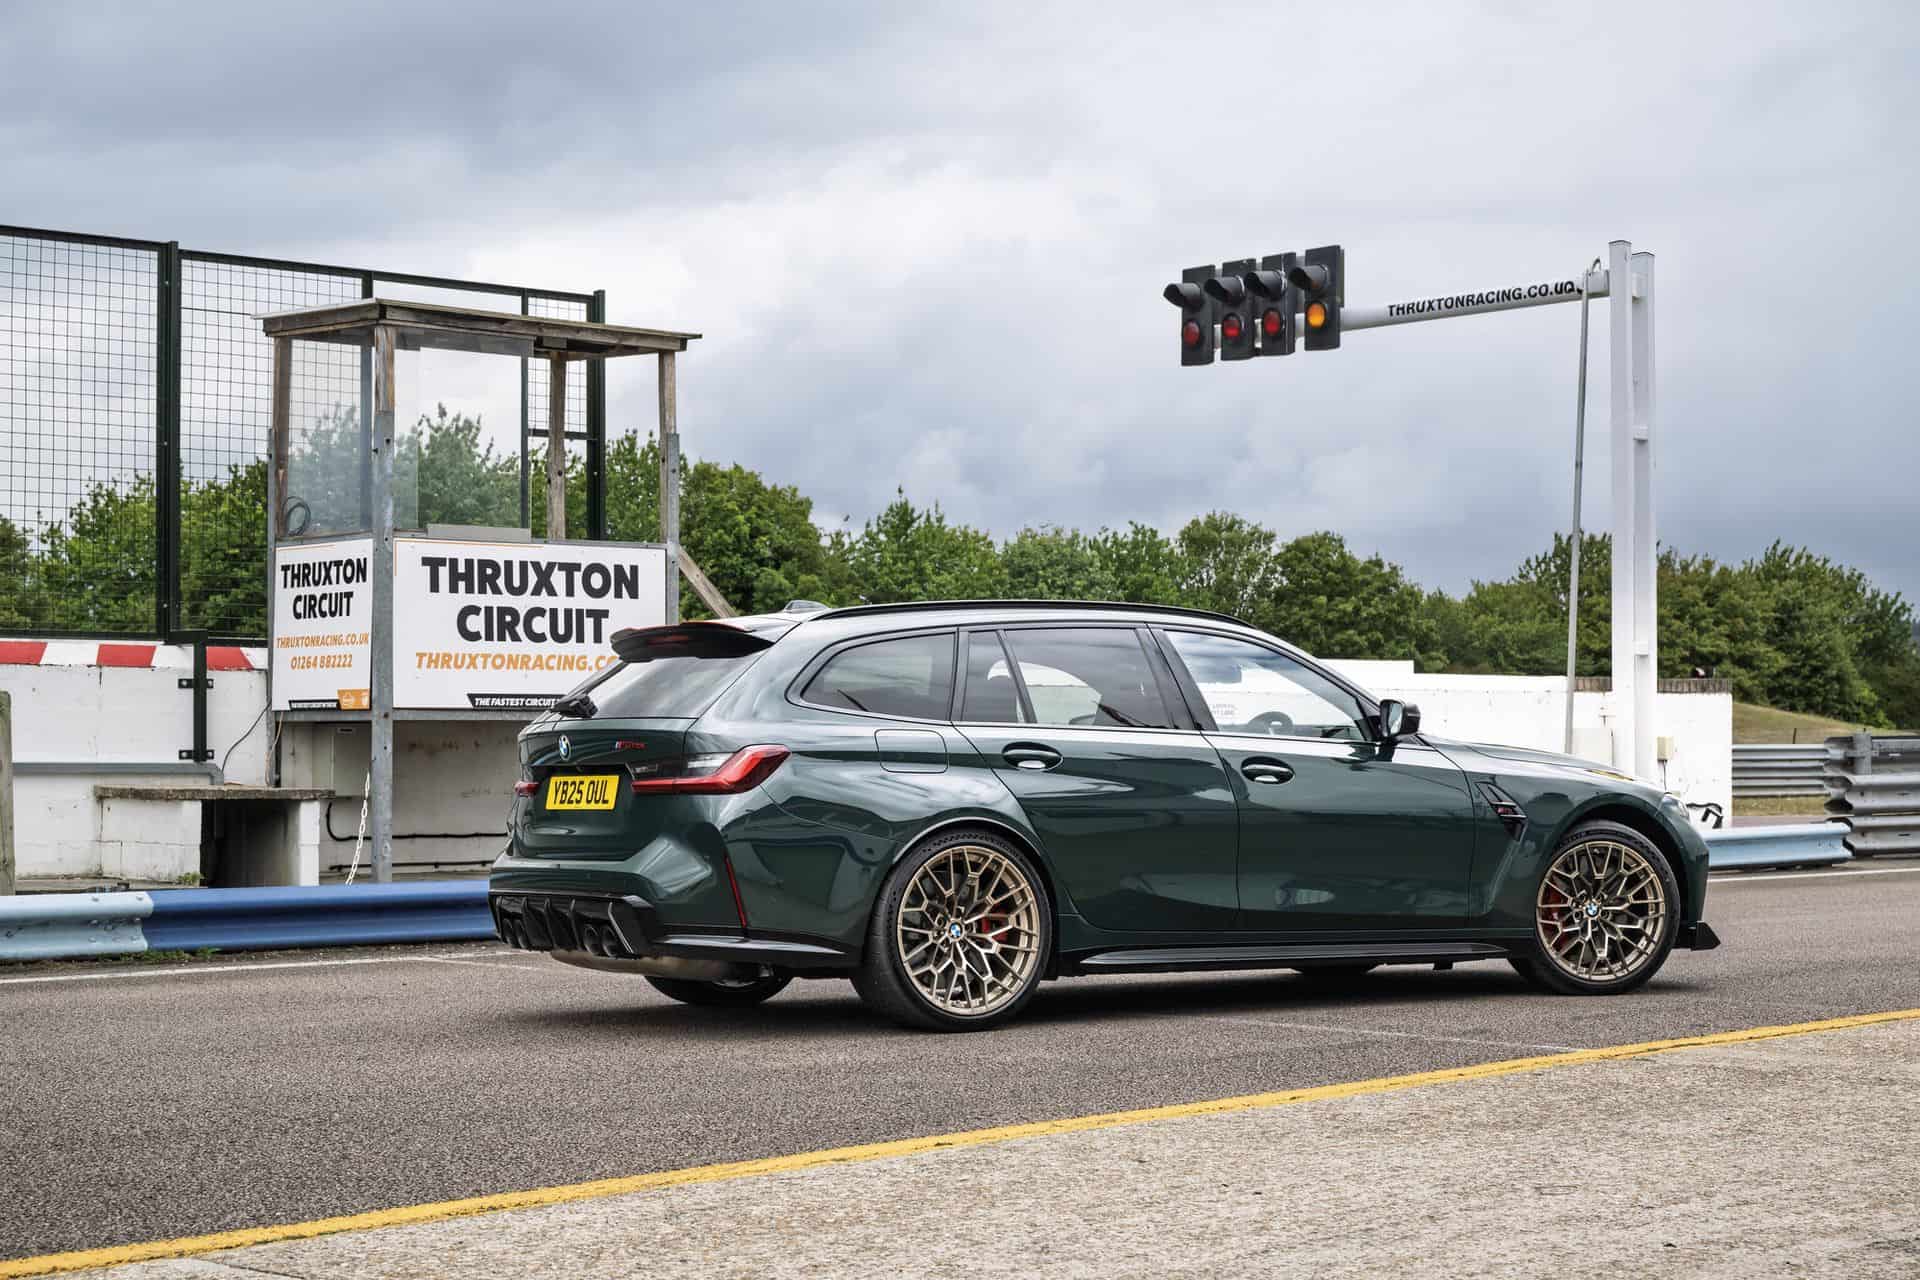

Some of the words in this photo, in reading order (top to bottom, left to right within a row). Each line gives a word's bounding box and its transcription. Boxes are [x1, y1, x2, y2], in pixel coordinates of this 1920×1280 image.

[281, 557, 367, 589] THRUXTON
[421, 556, 639, 600] THRUXTON
[293, 591, 353, 620] CIRCUIT
[457, 604, 610, 644] CIRCUIT
[290, 655, 318, 670] 01264
[475, 698, 490, 706] THE
[491, 698, 523, 706] FASTEST
[525, 698, 556, 708] CIRCUIT
[553, 780, 584, 805] YB25
[586, 780, 609, 804] OUL
